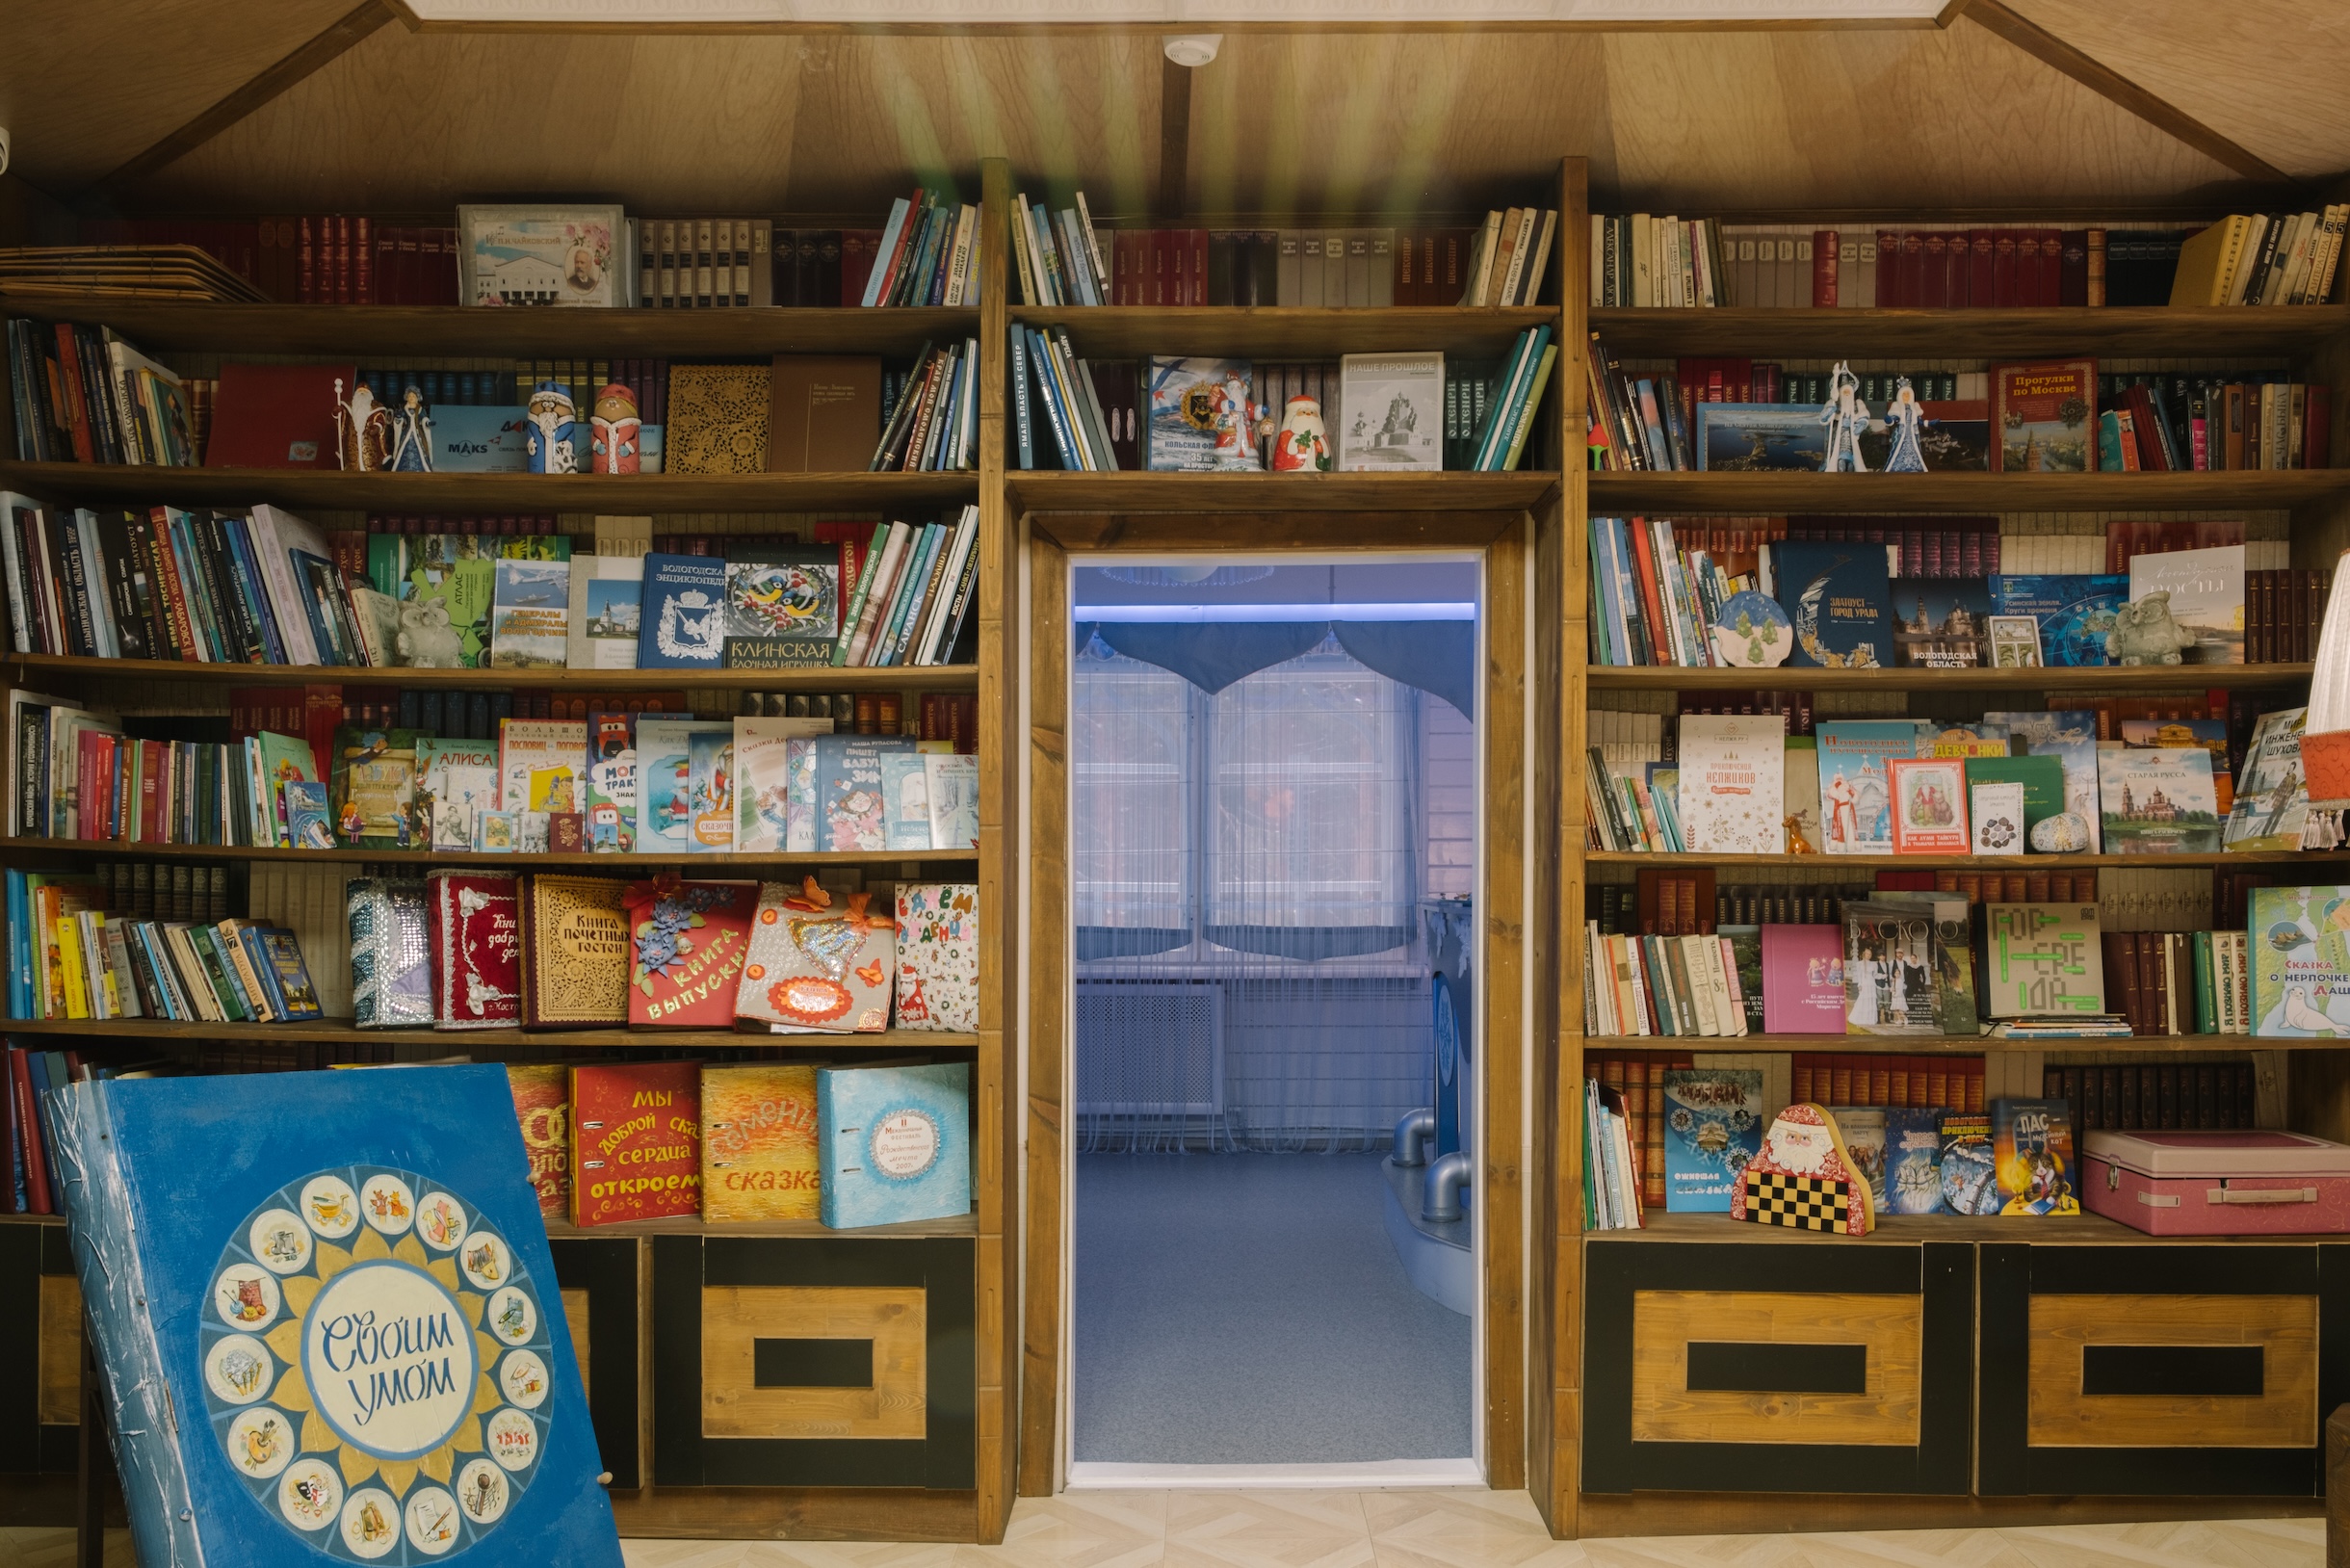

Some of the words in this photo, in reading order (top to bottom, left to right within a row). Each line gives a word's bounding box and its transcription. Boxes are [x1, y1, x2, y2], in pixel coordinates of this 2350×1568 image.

[2325, 222, 2333, 232] 5
[2337, 223, 2345, 233] 5
[1402, 238, 1412, 284] ШЕКСПИР
[1425, 238, 1435, 284] ШЕКСПИР
[1448, 238, 1457, 284] ШЕКСПИР
[1606, 226, 1616, 280] АЛЕКСАНДР
[2311, 240, 2329, 292] ЛИТЕРАТУРА
[2323, 240, 2340, 293] ЛИТЕРАТУРА
[1606, 284, 1616, 308] ДЮМ
[1059, 334, 1073, 359] АДРЕСА
[1015, 344, 1024, 372] СЕВЕР
[1349, 363, 1380, 374] НАШЕ
[1381, 360, 1436, 373] ПРОШЛОЕ
[2013, 388, 2027, 397] по
[2030, 385, 2077, 396] Москве
[2015, 375, 2075, 387] Прогулки
[927, 384, 937, 405] МОЙ
[1018, 383, 1027, 417] ВЛАСТЬ
[1448, 382, 1457, 425] ГЕНРИ
[1461, 382, 1471, 425] ГЕНРИ
[1448, 426, 1457, 438] О.
[1461, 426, 1471, 438] О.
[448, 441, 488, 456] MAKS
[1190, 453, 1203, 462] 35
[128, 525, 142, 570] ЗЛАТОУСТ
[70, 548, 84, 587] ОБЛАСТЬ
[156, 522, 168, 546] СТОЛИЦА
[162, 546, 174, 571] ДАЛЬНЕГО
[168, 571, 180, 595] ВОСТОКА
[150, 540, 171, 609] ТОСНЕНСКАЯ
[662, 564, 725, 577] ВОЛОГОДСКА
[230, 564, 247, 606] АРХАНГЕЛЬСК
[455, 573, 463, 605] АТЛАС
[850, 595, 863, 617] ЗЕМЛИ
[859, 549, 878, 594] ВОЛОГОДСКОЙ
[951, 594, 963, 617] МОСТЫ
[1830, 597, 1866, 608] ЗЛАТОУСТ
[2004, 599, 2037, 608] Усинская
[77, 589, 93, 649] УЛЬЯНОВСКАЯ
[510, 610, 561, 618] ГЕНЕРАЛЫ
[1830, 608, 1854, 618] ГОРОД
[1855, 608, 1879, 618] УРАЛА
[167, 613, 179, 648] ЗЕМЛЯ
[174, 601, 192, 648] ХАБАРОВСК
[898, 595, 924, 654] САРАНСК
[731, 641, 830, 659] КЛИНСКАЯ
[1914, 652, 1978, 661] ВОЛОГОДСКАЯ
[731, 659, 778, 668] ЁЛОЧНАЯ
[780, 660, 830, 668] ИГРУШКА
[2283, 718, 2304, 731] МИР
[509, 740, 547, 751] ПОСЛОВИЦ
[557, 740, 588, 751] ПОГОВОР
[743, 740, 773, 754] Сказки
[2265, 730, 2306, 745] ИНЖЕНЕ
[439, 753, 493, 766] АЛИСА
[846, 747, 877, 756] ПИШЕТ
[1707, 771, 1756, 785] НЕЛЖИКОВ
[1849, 918, 1929, 941] БАСКО
[228, 937, 239, 949] 7
[139, 948, 153, 982] КУПРИН
[673, 928, 740, 988] КНИГА
[1710, 940, 1721, 974] Повесть
[2225, 952, 2234, 971] МИР
[2239, 952, 2249, 971] МИР
[2284, 959, 2335, 971] СКАЗКА
[235, 950, 259, 1003] ЛИТЕРАТУРА
[2285, 974, 2349, 982] НЕРПОЧКЕ
[2225, 972, 2234, 1014] ПОЗНАЮ
[2239, 972, 2249, 1014] ПОЗНАЮ
[2313, 983, 2350, 997] ДАШ
[2225, 1016, 2234, 1027] Я
[2239, 1016, 2249, 1027] Я
[632, 1090, 672, 1109] МЫ
[2020, 1113, 2050, 1133] ПАС
[322, 1310, 455, 1372] Своим
[348, 1357, 457, 1426] умом
